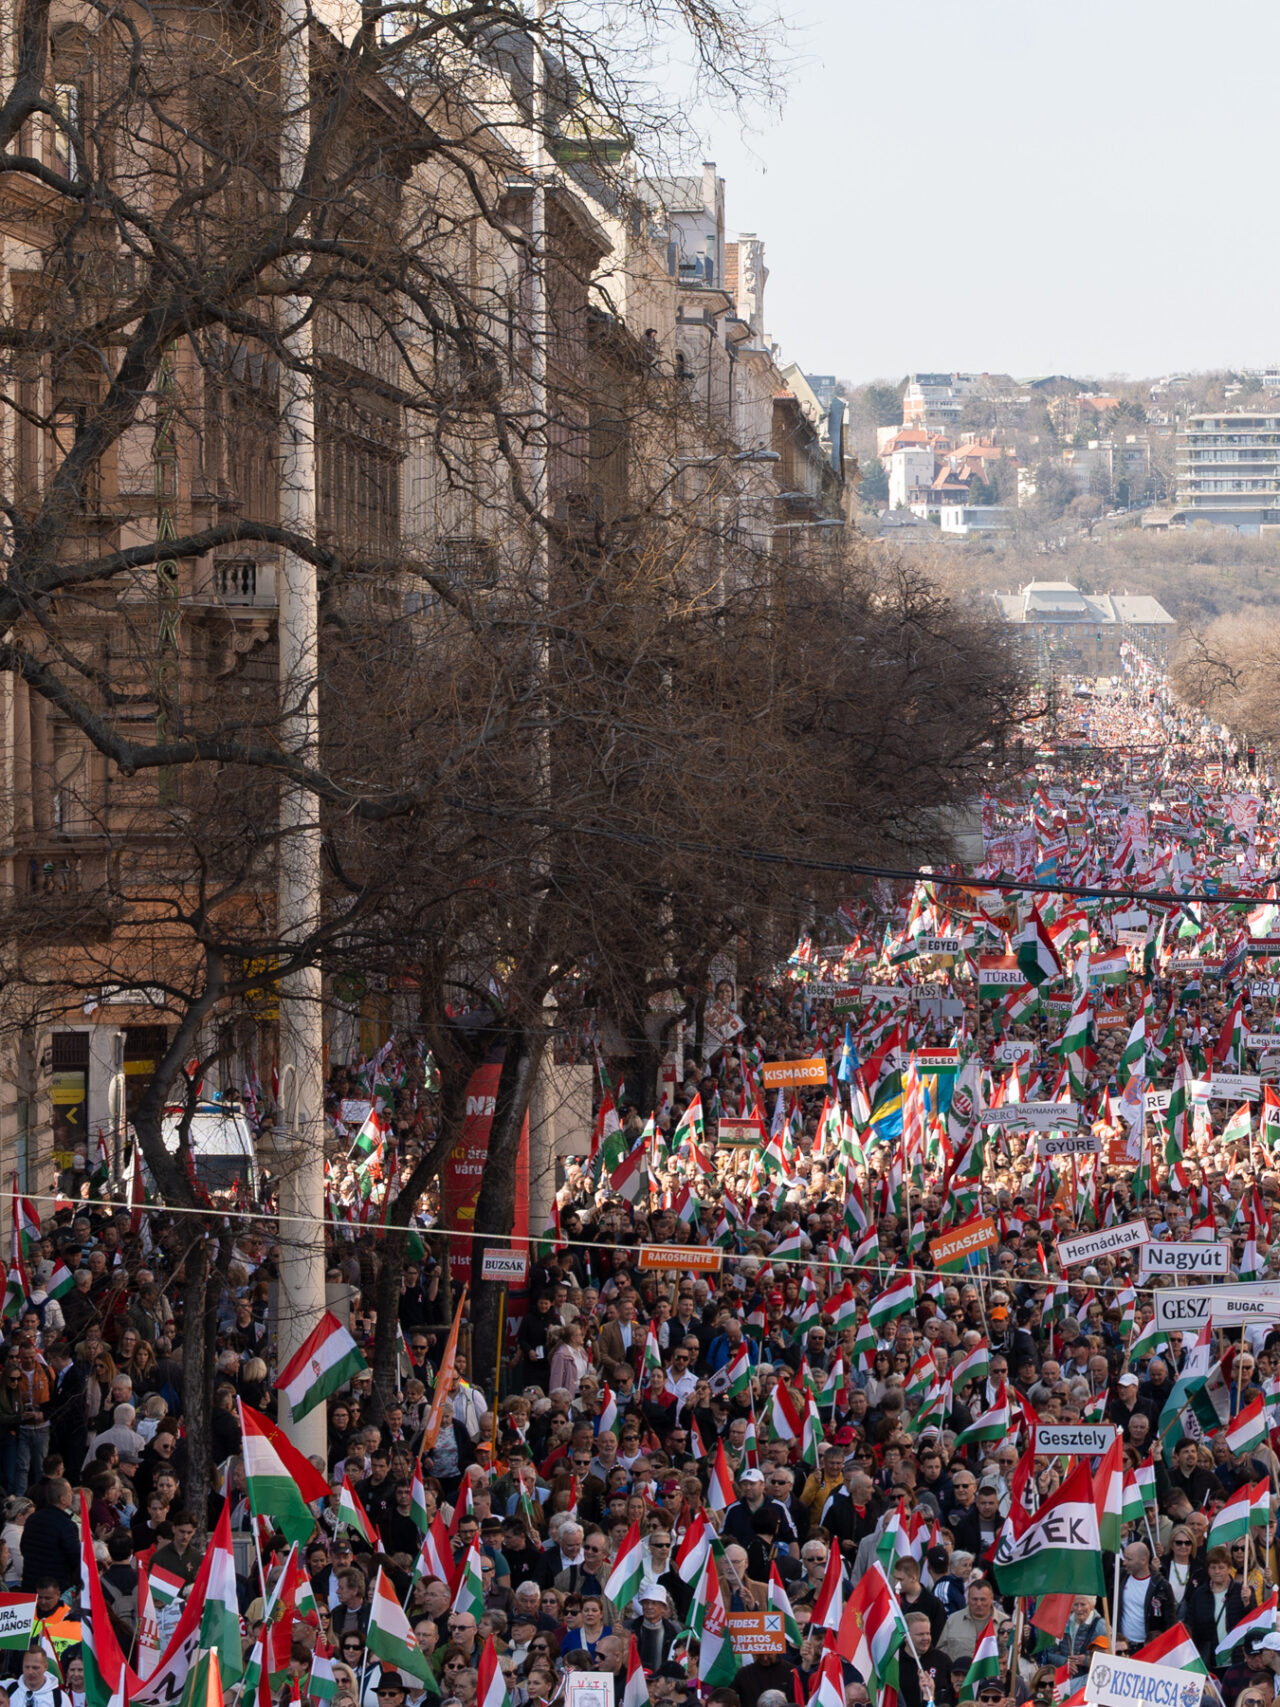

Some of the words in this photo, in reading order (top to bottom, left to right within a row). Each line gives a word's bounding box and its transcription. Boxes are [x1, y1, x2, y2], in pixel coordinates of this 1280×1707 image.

[928, 940, 959, 951] EGYED
[914, 985, 938, 999] TASS
[920, 1057, 955, 1065] BELED
[763, 1065, 826, 1081] KISMAROS
[934, 1229, 996, 1261] BÁTASZÉK
[1067, 1227, 1141, 1259] Hernádkak
[484, 1256, 526, 1272] BUZSÁK
[1148, 1249, 1223, 1269] Nagyút
[1162, 1298, 1212, 1320] GESZ
[1227, 1301, 1265, 1313] BUGAC
[1038, 1430, 1107, 1449] Gesztely
[728, 1619, 760, 1629] FIDESZ
[737, 1634, 771, 1643] BIZTOS
[1109, 1671, 1179, 1707] KISTARCSA
